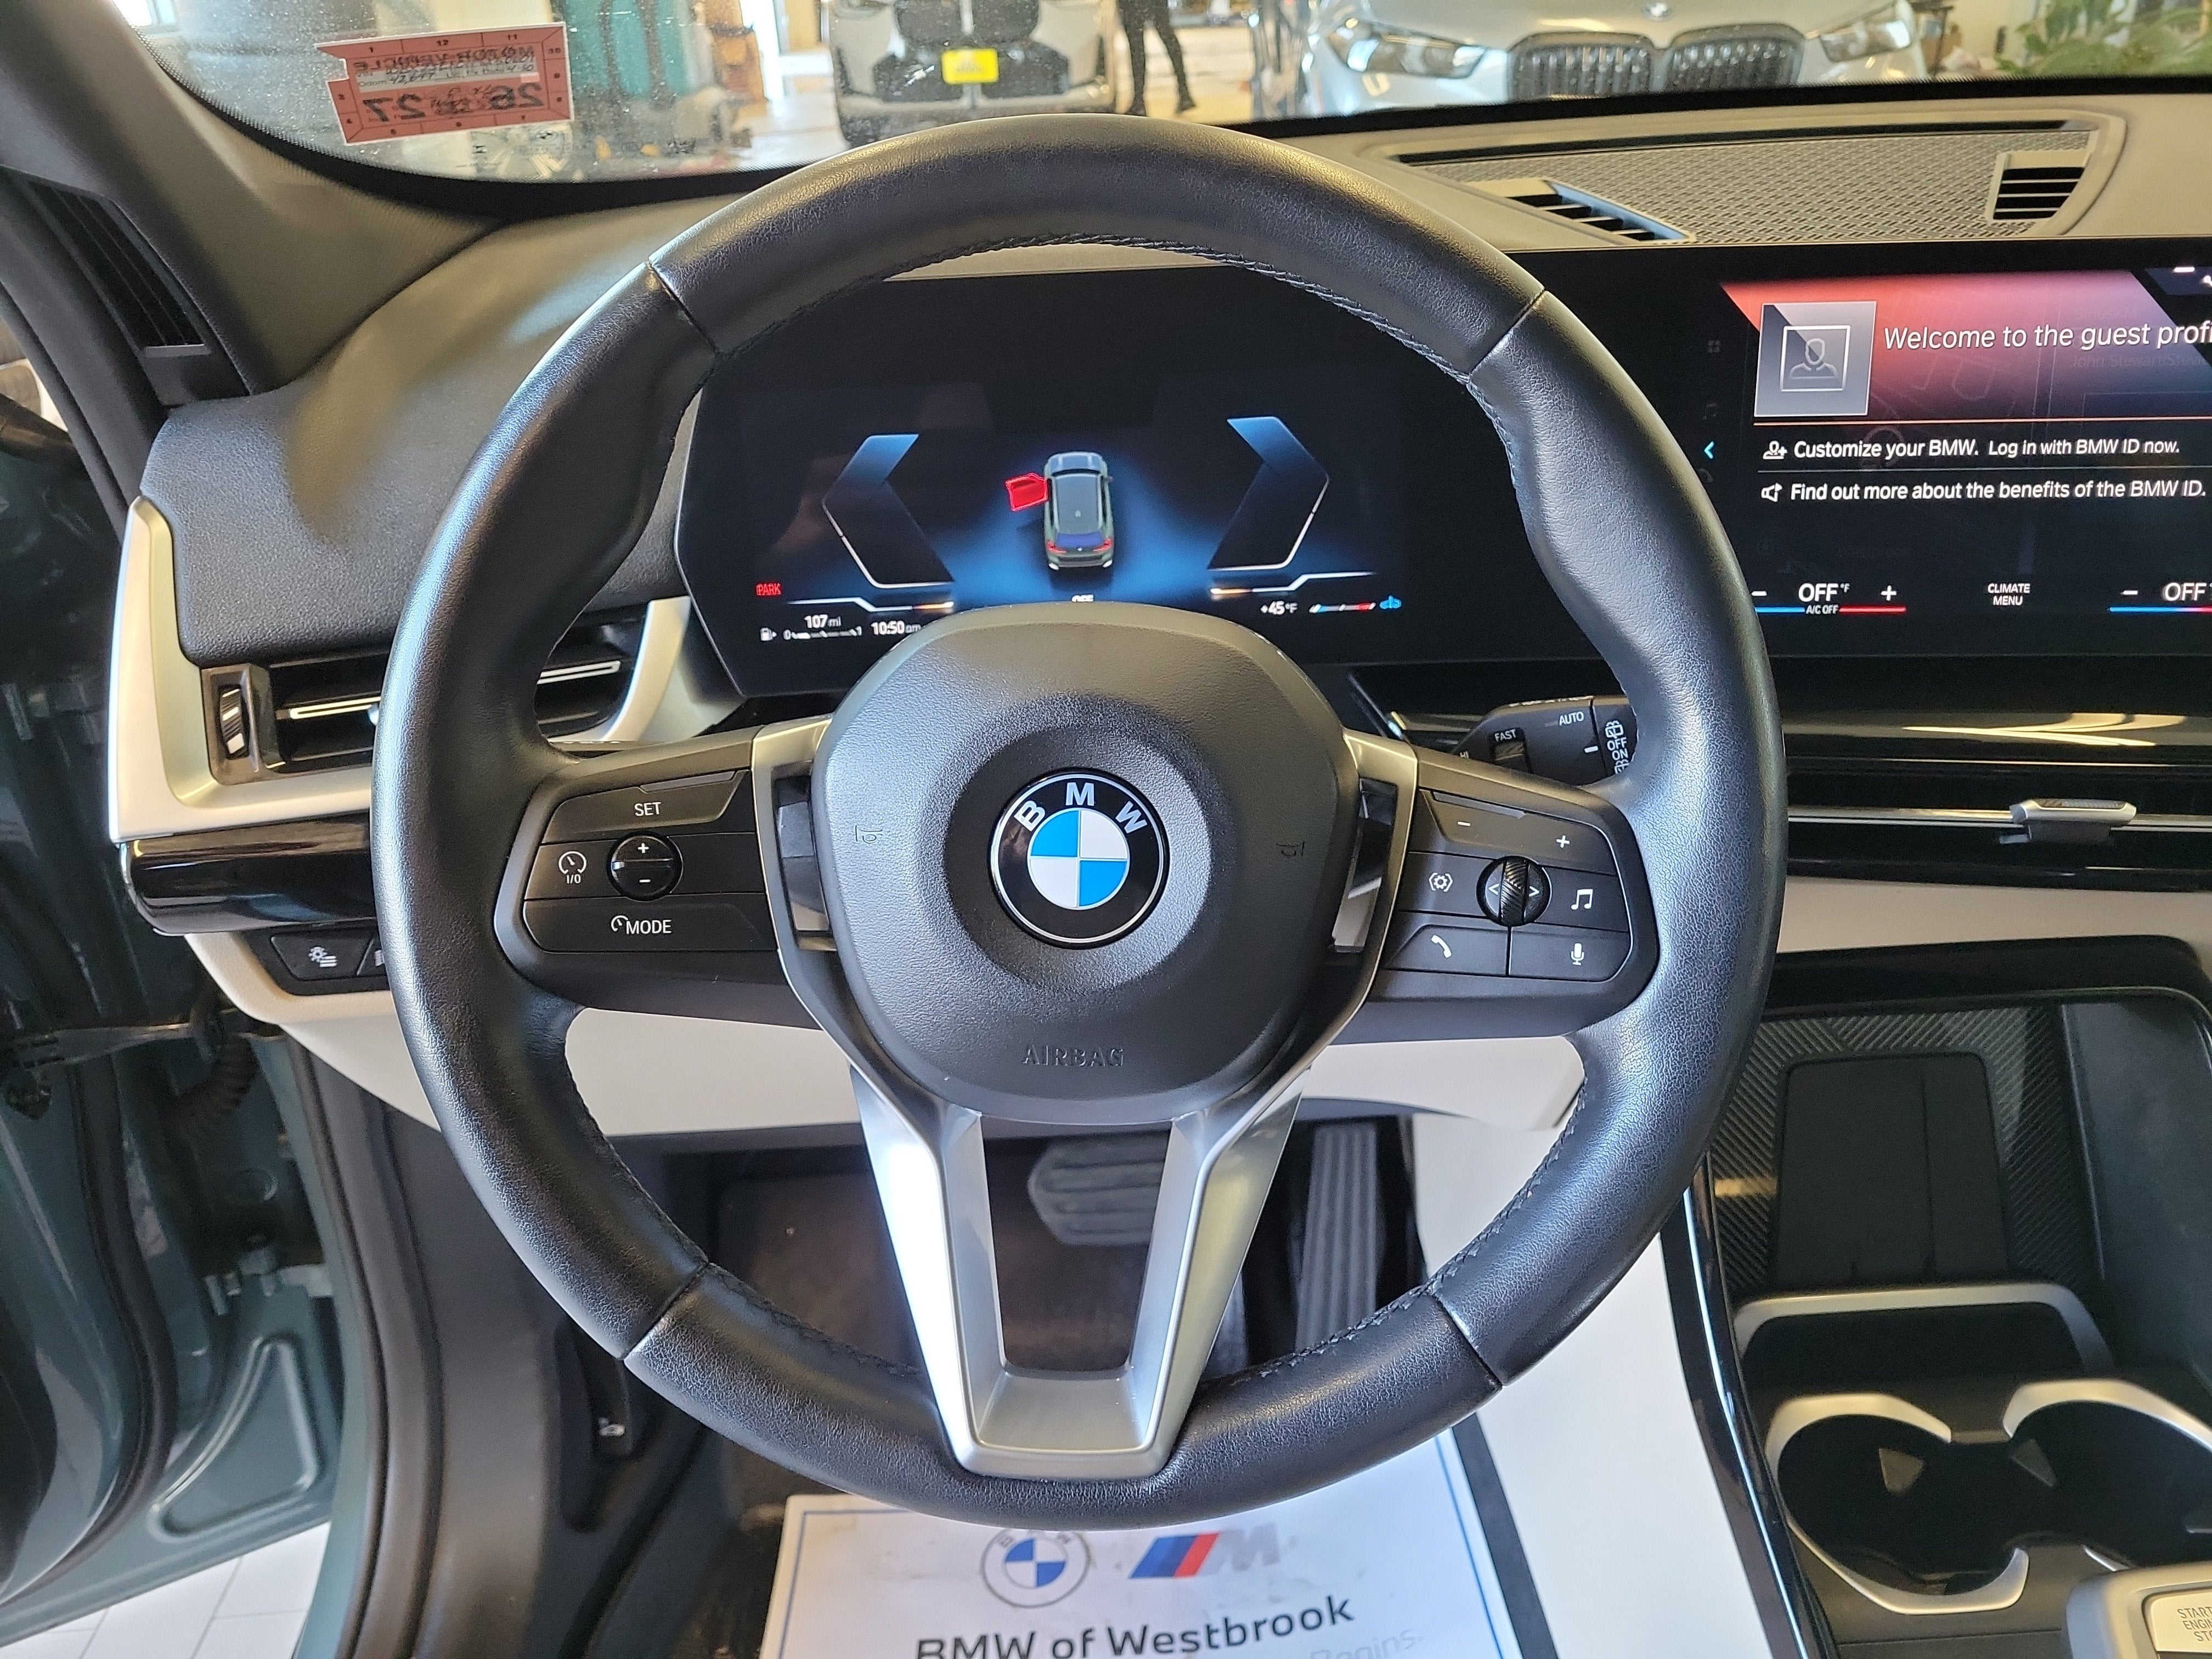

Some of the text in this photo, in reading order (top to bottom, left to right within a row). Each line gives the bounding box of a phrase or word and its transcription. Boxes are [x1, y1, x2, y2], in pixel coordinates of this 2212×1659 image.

[1884, 326, 1995, 349] Welcome
[2002, 325, 2028, 348] to
[2034, 324, 2073, 347] the
[2081, 323, 2151, 351] guest
[1793, 438, 2180, 460] Customize your BMW. Log in with BMW ID now.
[1790, 479, 2206, 500] Find out more about the benefits of the BMW ID.
[755, 583, 781, 596] PARK
[1798, 583, 1838, 602] OFF
[1987, 583, 2030, 594] CLIMATE
[2164, 582, 2207, 601] OFF
[1993, 595, 2023, 606] MENU
[1822, 604, 1839, 615] OFF
[804, 614, 828, 629] 107
[871, 620, 906, 635] 10:50
[1559, 712, 1584, 726] AUTO
[1494, 729, 1516, 742] FAST
[1607, 736, 1627, 751] OFF
[1612, 747, 1629, 760] ON
[634, 802, 662, 816] SET
[1014, 782, 1148, 834] BMW
[626, 919, 672, 935] MODE
[1023, 1043, 1124, 1067] AIRBAG
[2177, 1606, 2212, 1619] START
[917, 1594, 1354, 1659] BMW of Westbrook
[2182, 1618, 2212, 1630] ENGI
